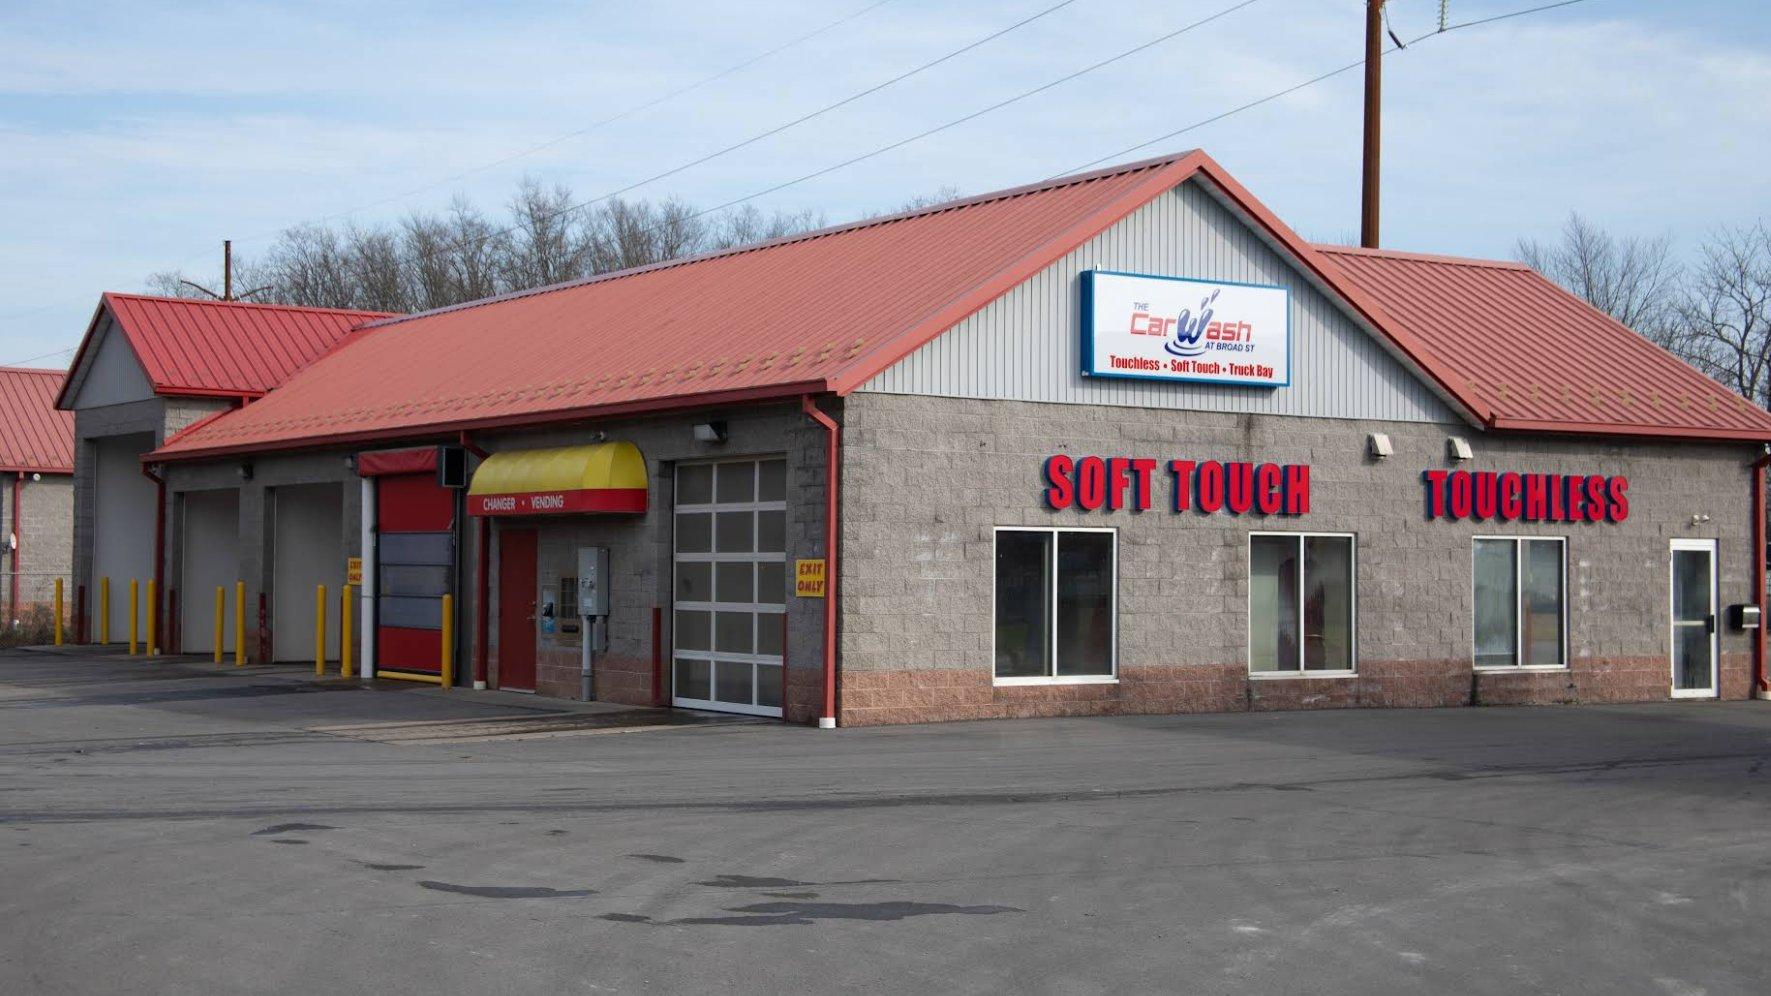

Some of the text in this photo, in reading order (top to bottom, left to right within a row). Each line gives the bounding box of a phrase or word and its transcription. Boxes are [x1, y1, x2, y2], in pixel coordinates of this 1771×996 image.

[1134, 302, 1149, 311] THE
[1204, 341, 1256, 353] AT BROAD ST
[1110, 355, 1274, 379] Touchless Soft Touch Truck Bay
[1043, 454, 1310, 515] SOFT TOUCH
[483, 495, 564, 511] CHANGER VENDING
[1422, 469, 1629, 523] TOUCHLESS
[800, 563, 823, 576] EXIT
[798, 580, 823, 592] ONLY
